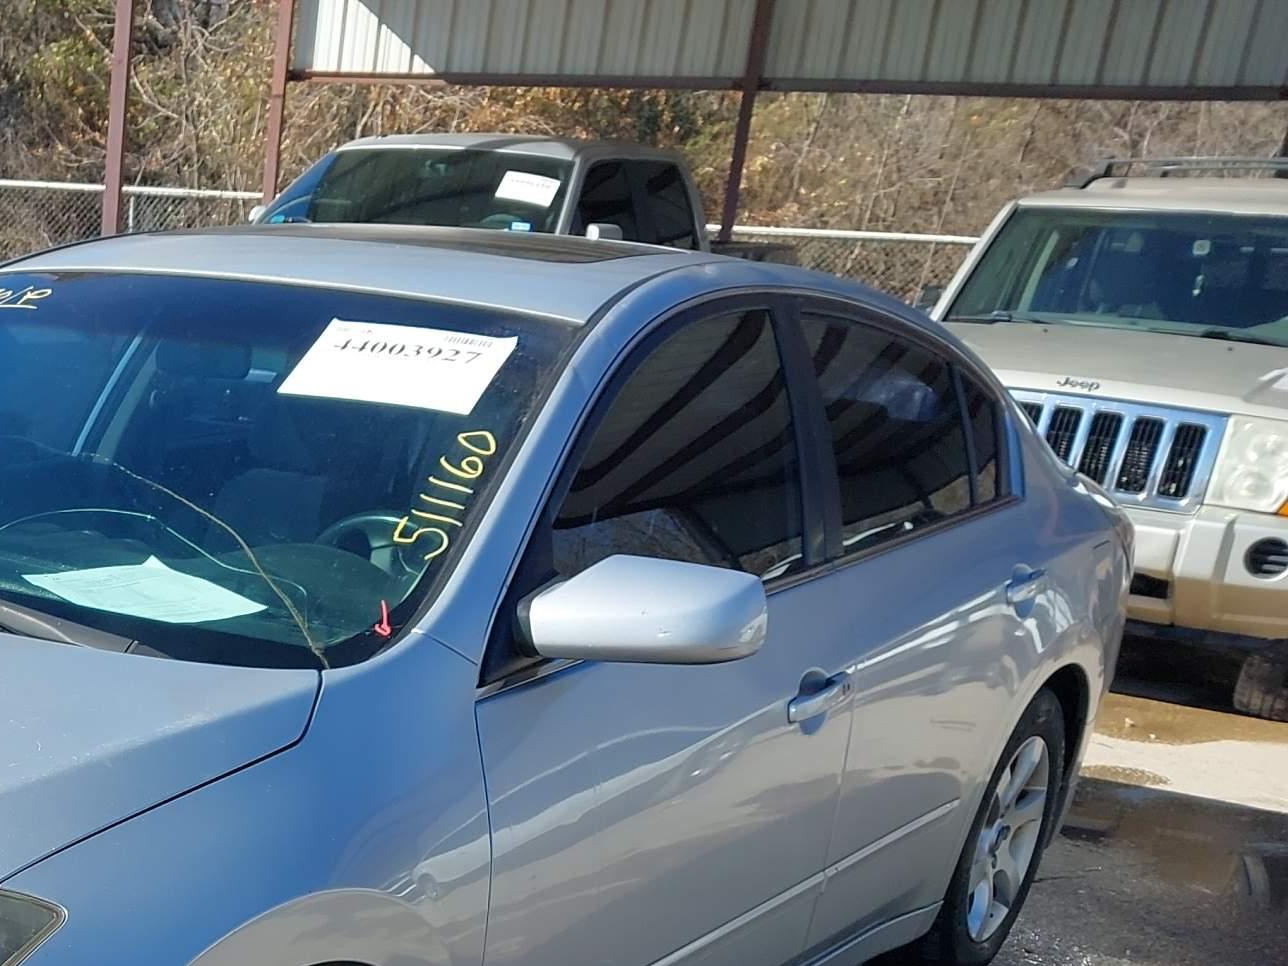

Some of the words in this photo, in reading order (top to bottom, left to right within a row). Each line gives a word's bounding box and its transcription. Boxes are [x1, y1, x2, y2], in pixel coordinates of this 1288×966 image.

[333, 338, 482, 364] 44003927
[1056, 377, 1100, 392] Jeep
[393, 430, 497, 561] 511160
